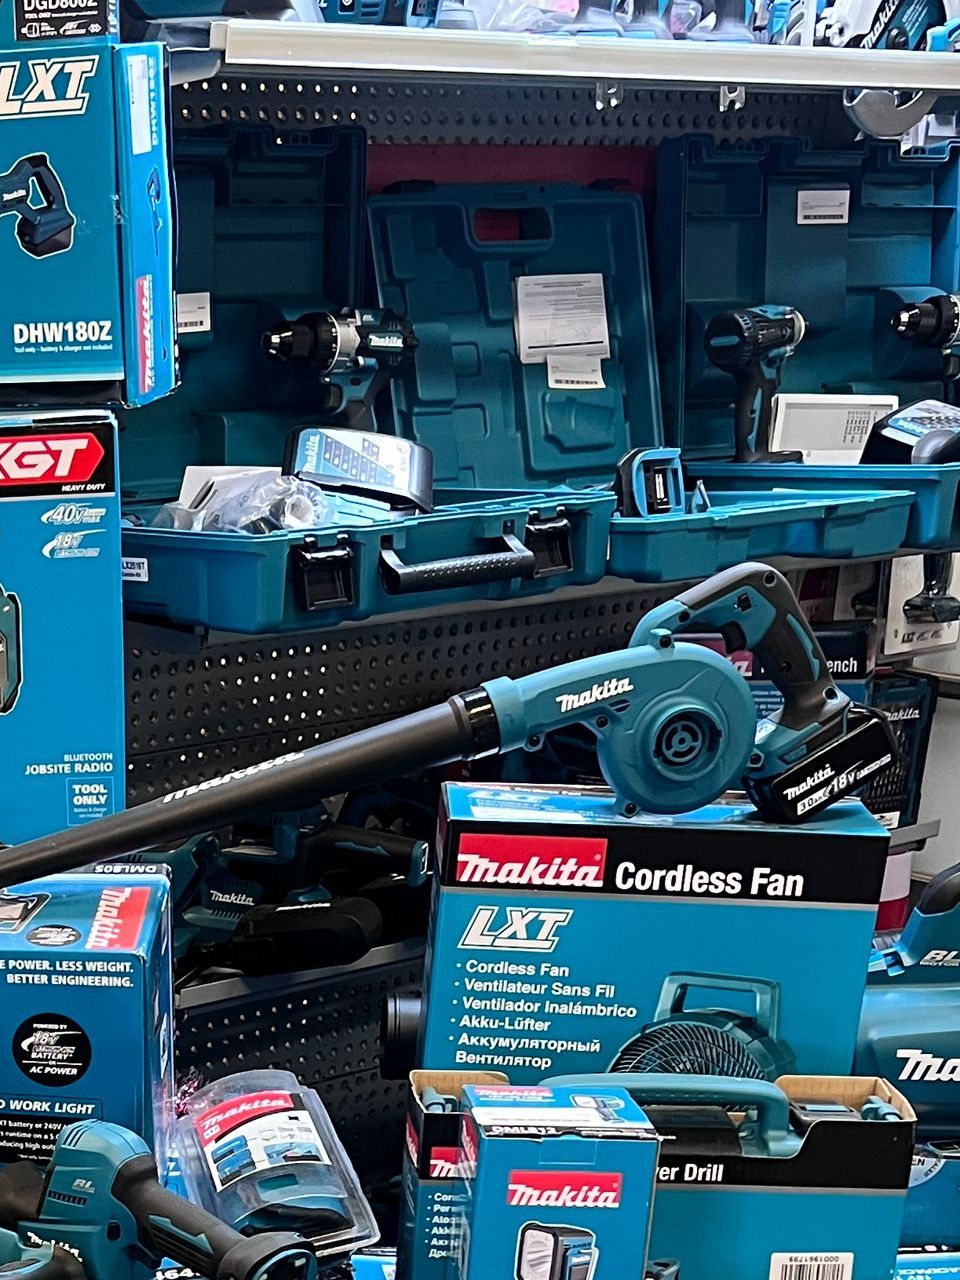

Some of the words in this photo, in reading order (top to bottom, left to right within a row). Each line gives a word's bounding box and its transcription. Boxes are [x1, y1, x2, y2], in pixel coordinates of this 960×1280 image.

[13, 320, 113, 344] DHW180Z
[62, 484, 85, 492] HEAVY
[86, 483, 106, 491] DUTY
[555, 676, 634, 713] makita
[64, 752, 113, 762] BLUETOOTH
[25, 763, 72, 776] JOBSITE
[74, 762, 114, 773] RADIO
[72, 784, 108, 794] TOOL
[73, 794, 108, 805] ONLY
[457, 853, 604, 888] makita
[615, 861, 743, 894] Cordless
[751, 867, 805, 898] Fan
[457, 904, 575, 953] LXT
[8, 960, 53, 971] POWER.
[55, 961, 83, 971] LESS
[84, 961, 134, 973] WEIGHT.
[465, 959, 536, 976] Cordless
[541, 963, 569, 978] Fan
[6, 973, 49, 984] BETTER
[51, 974, 134, 987] ENGINEERING.
[464, 978, 548, 996] Ventilateur
[551, 982, 591, 996] Sans
[595, 984, 615, 998] Fil
[462, 996, 542, 1013] Ventilador
[544, 1000, 638, 1018] Inalámbrico
[459, 1015, 551, 1032] Akku-Lüfter
[458, 1033, 601, 1053] Аккумуляторный
[455, 1051, 552, 1069] Вентилятор
[29, 1066, 44, 1074] AC
[45, 1067, 78, 1075] POWER
[10, 1100, 50, 1112] WORK
[54, 1103, 96, 1115] LIGHT
[8, 1120, 34, 1129] battery
[5, 1131, 32, 1139] runtime
[24, 1141, 40, 1150] high
[683, 1163, 725, 1182] Drill
[508, 1184, 620, 1209] makita
